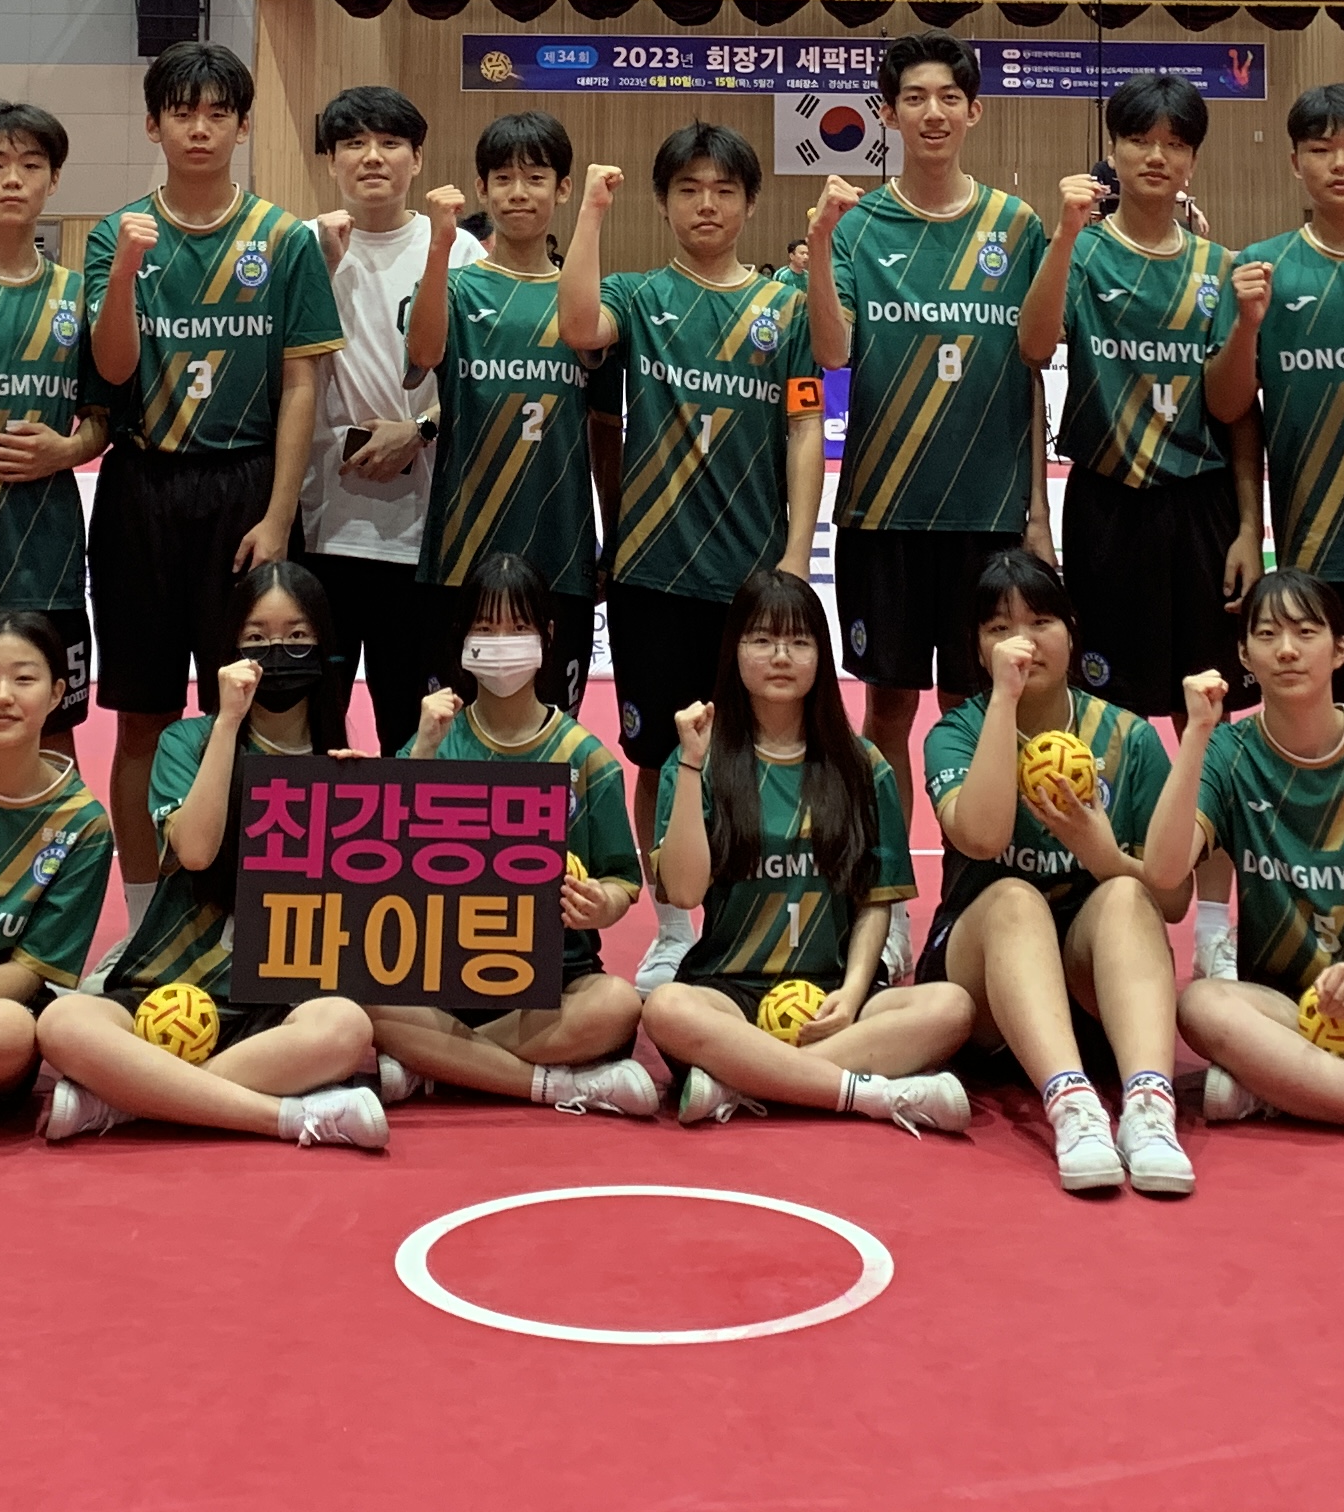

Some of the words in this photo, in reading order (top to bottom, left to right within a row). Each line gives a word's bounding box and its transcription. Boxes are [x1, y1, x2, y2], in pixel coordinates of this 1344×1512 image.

[613, 47, 694, 68] 2023년
[706, 46, 784, 74] 회장기
[796, 46, 884, 75] 세팍타
[576, 77, 609, 87] 대회기간
[618, 77, 648, 87] 2023년
[649, 76, 667, 88] 6월
[787, 79, 819, 88] 대회장소
[141, 315, 273, 339] ONGMYUNG
[867, 300, 1020, 327] DONGMYUNG
[938, 343, 962, 382] 8
[1090, 335, 1206, 364] DONGMYU
[187, 360, 212, 399] 3
[640, 354, 782, 404] DONGMYUNG
[522, 402, 545, 441] 2
[1152, 383, 1178, 422] 4
[700, 414, 713, 454] 1
[66, 641, 86, 689] 5
[566, 659, 579, 706] 2
[243, 778, 567, 886] 최강동명
[259, 892, 535, 996] 파이팅
[787, 902, 800, 947] 1
[1313, 912, 1342, 953] 5
